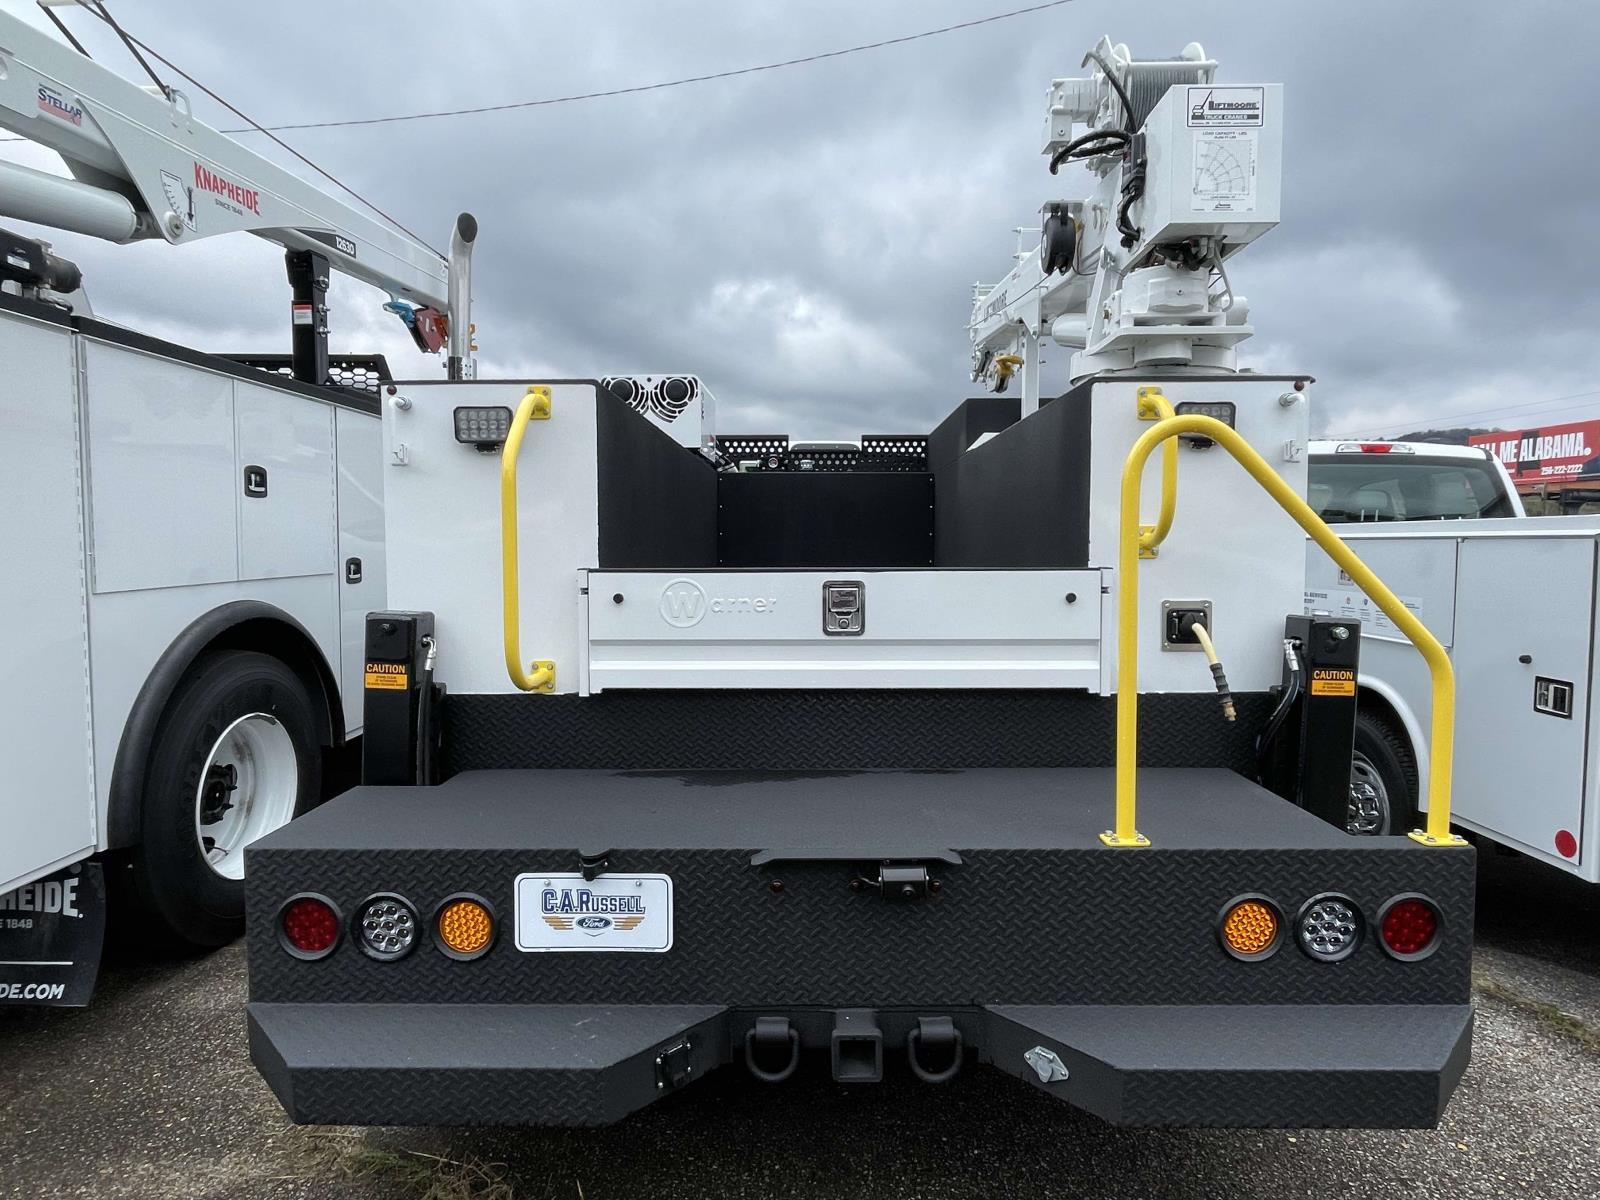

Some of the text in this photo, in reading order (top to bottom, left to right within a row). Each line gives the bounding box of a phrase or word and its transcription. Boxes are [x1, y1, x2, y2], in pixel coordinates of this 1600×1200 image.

[38, 88, 82, 119] STELLAR
[194, 161, 260, 216] KNAPHEIDE
[335, 235, 355, 255] 12630
[1499, 440, 1519, 463] ME
[664, 590, 778, 620] Warner
[366, 664, 406, 674] CAUTION
[1313, 670, 1353, 680] CAUTION
[6, 919, 33, 929] 1848
[583, 917, 606, 928] Ford
